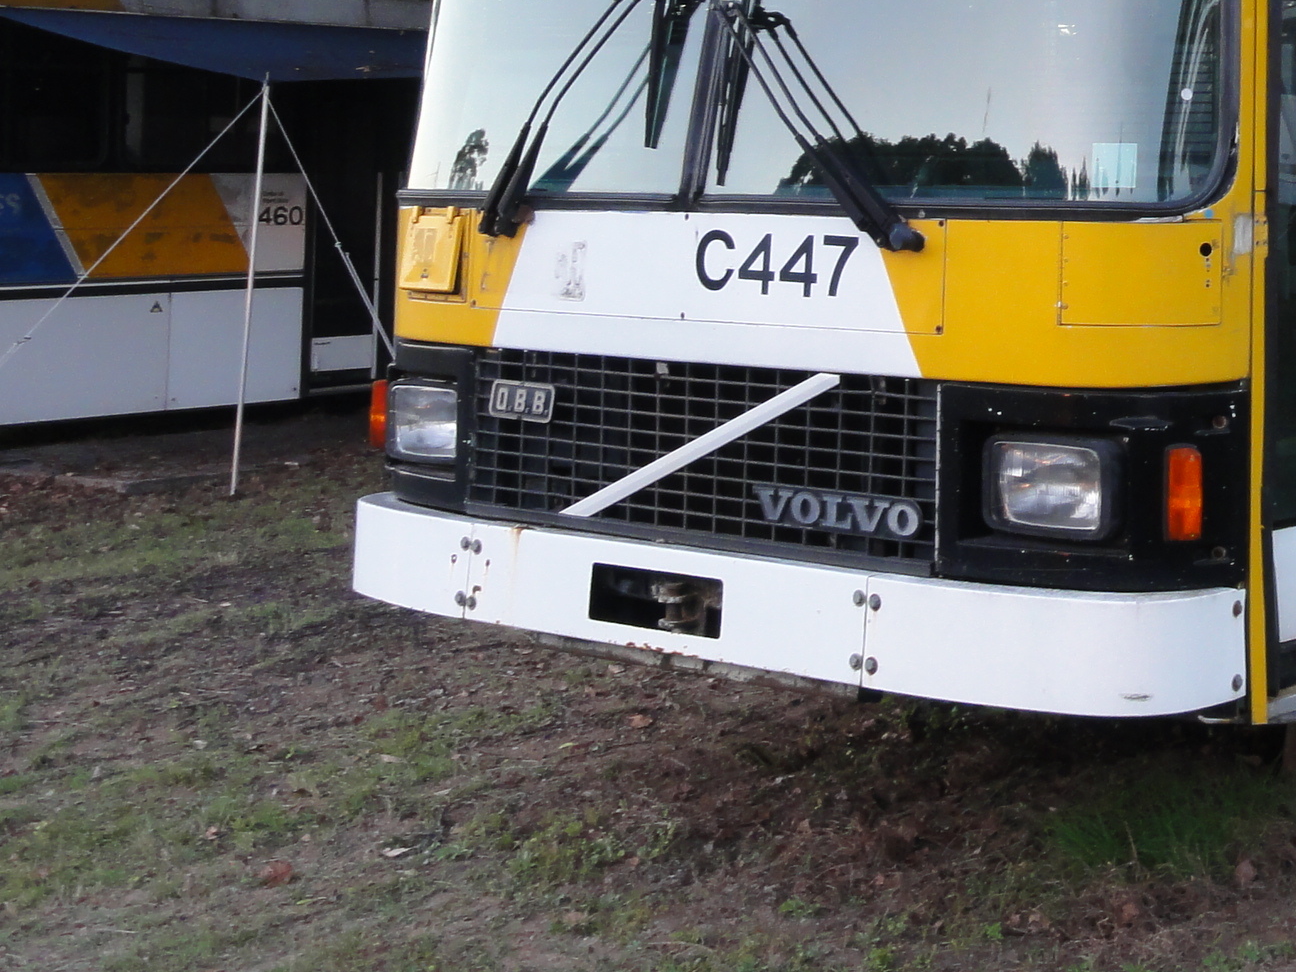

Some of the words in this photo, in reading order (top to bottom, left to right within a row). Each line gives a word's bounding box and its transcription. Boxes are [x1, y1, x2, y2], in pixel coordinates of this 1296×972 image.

[258, 205, 304, 226] 460
[695, 229, 861, 298] C447
[753, 484, 921, 539] VOLVO
